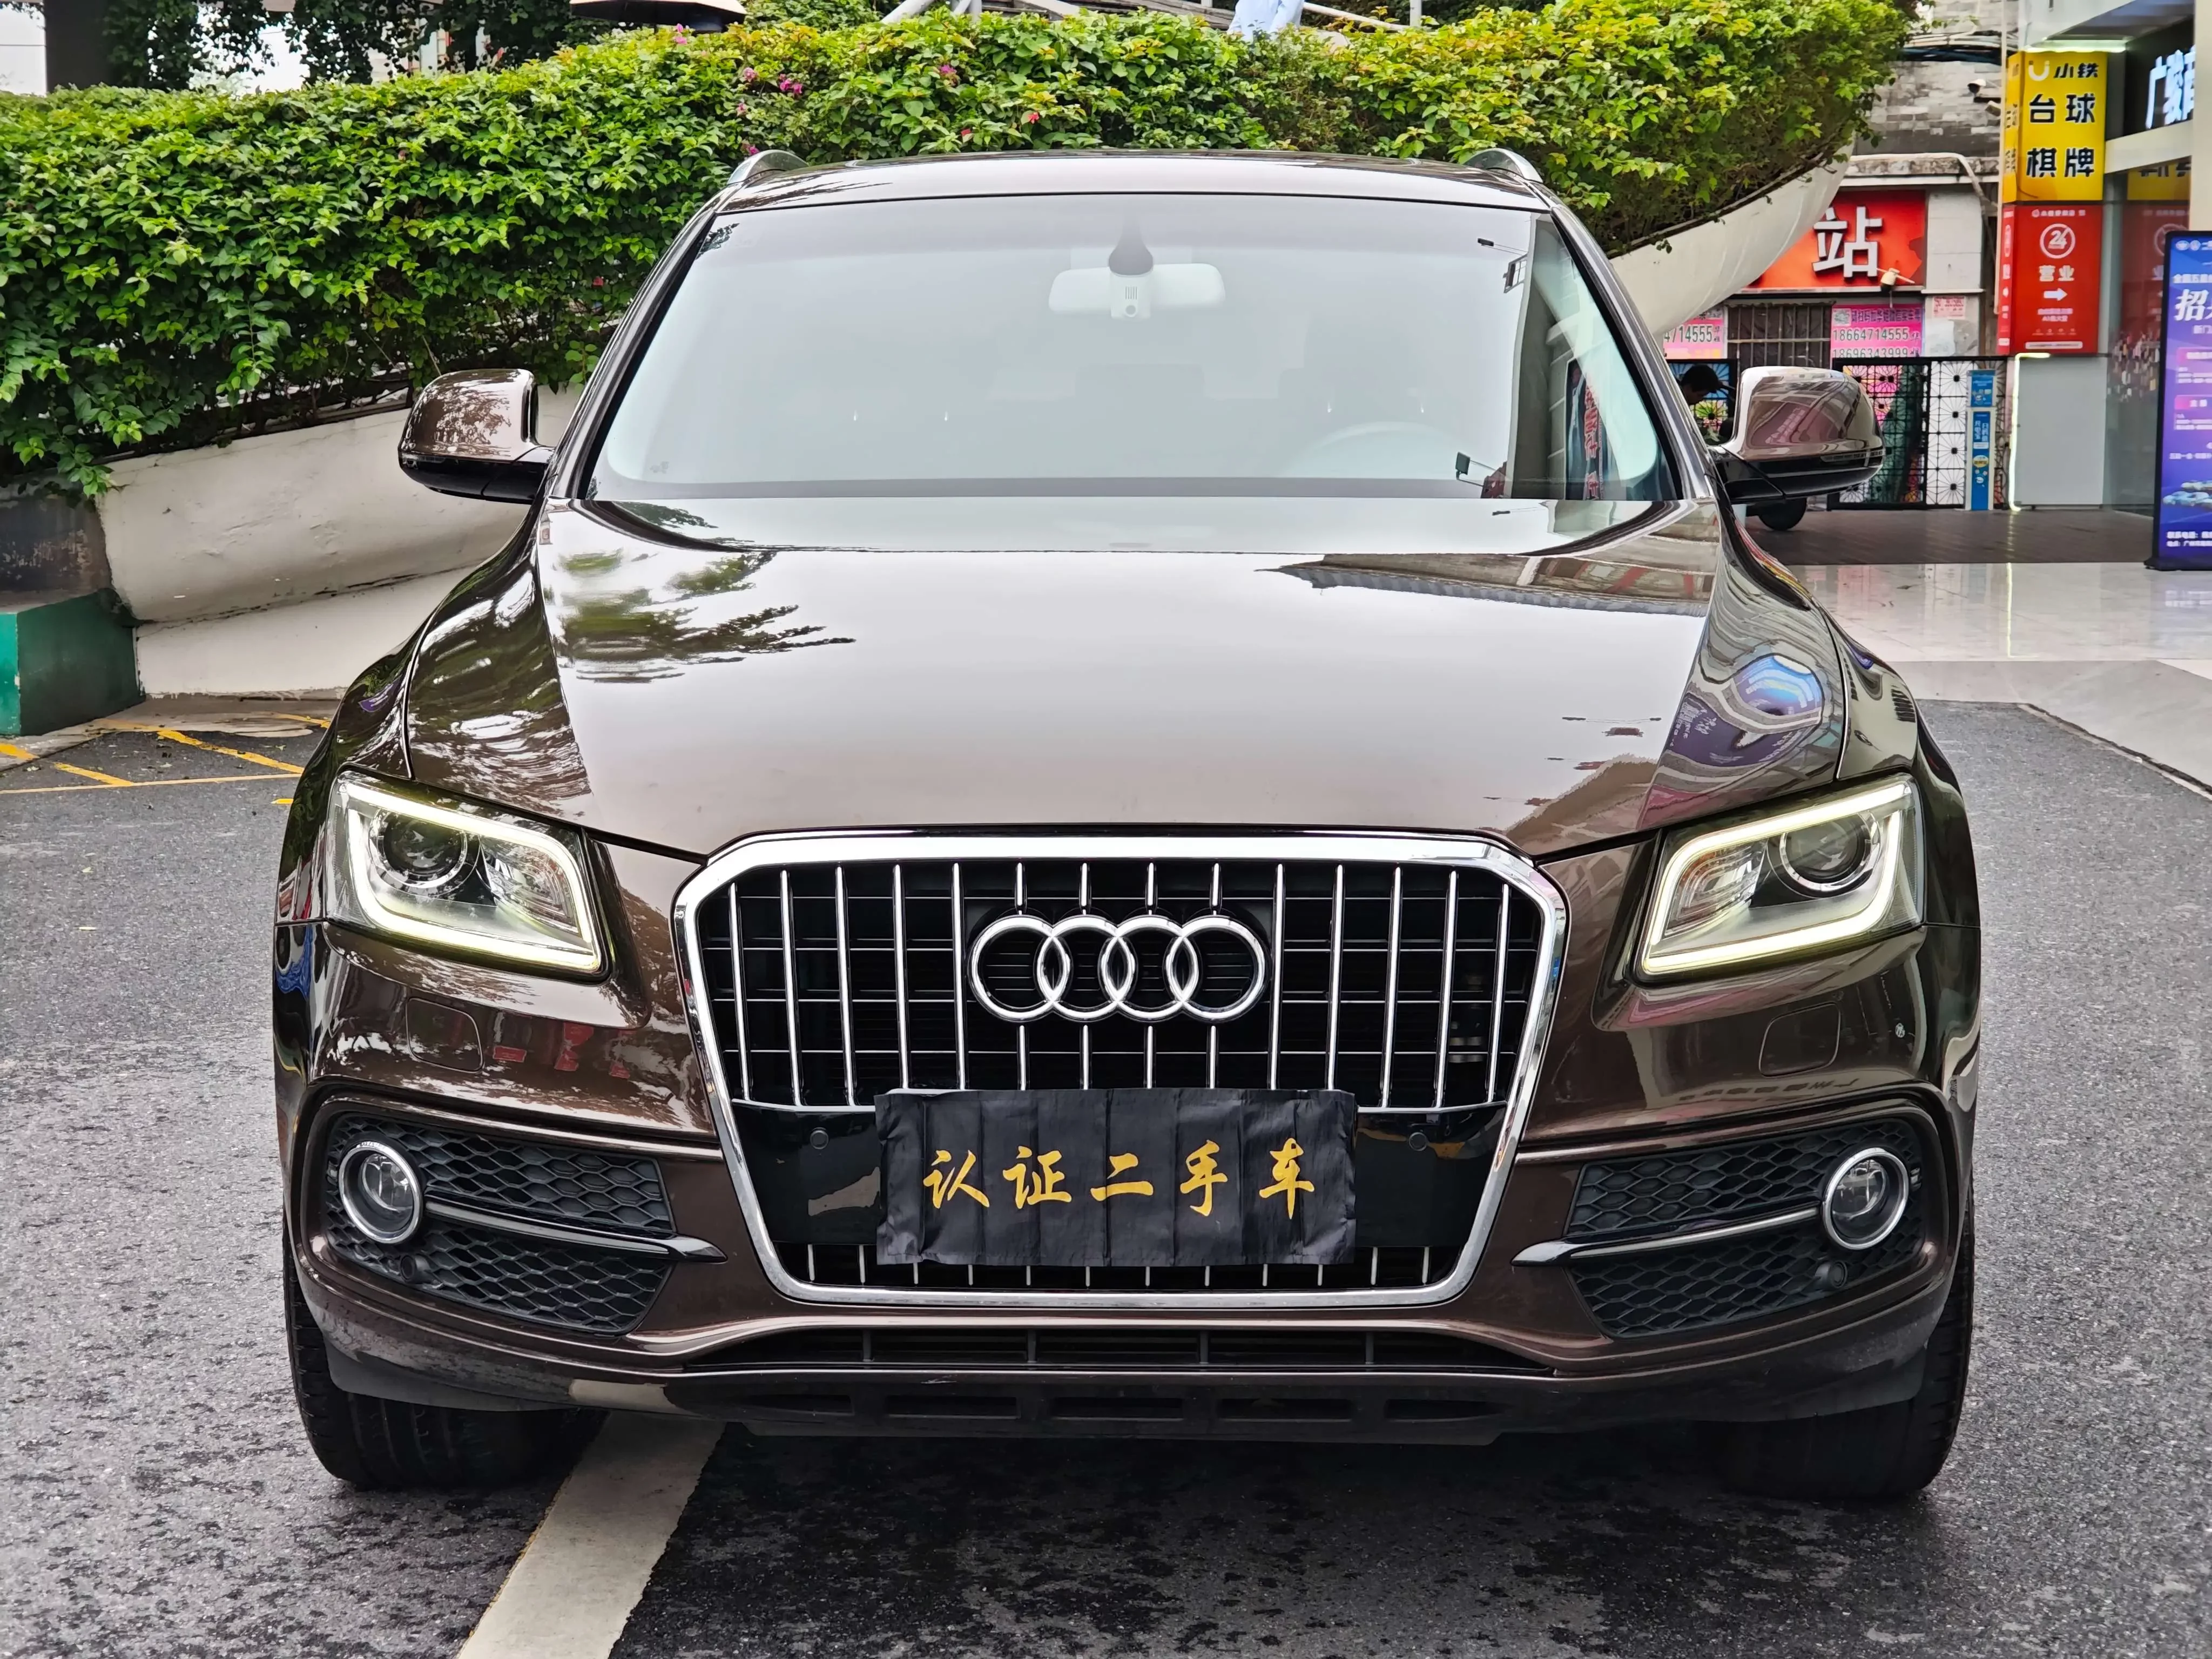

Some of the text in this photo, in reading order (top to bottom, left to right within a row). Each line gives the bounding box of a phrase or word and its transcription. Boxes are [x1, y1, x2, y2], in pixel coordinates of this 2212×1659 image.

[2054, 63, 2099, 78] 小铁
[2028, 93, 2096, 123] 台球
[2026, 147, 2095, 178] 棋牌
[1812, 206, 1883, 278] 站
[2038, 265, 2075, 282] 营业
[2174, 288, 2212, 321] 招
[1832, 328, 1909, 342] 18664714555
[922, 1137, 1315, 1220] 认证二手车
